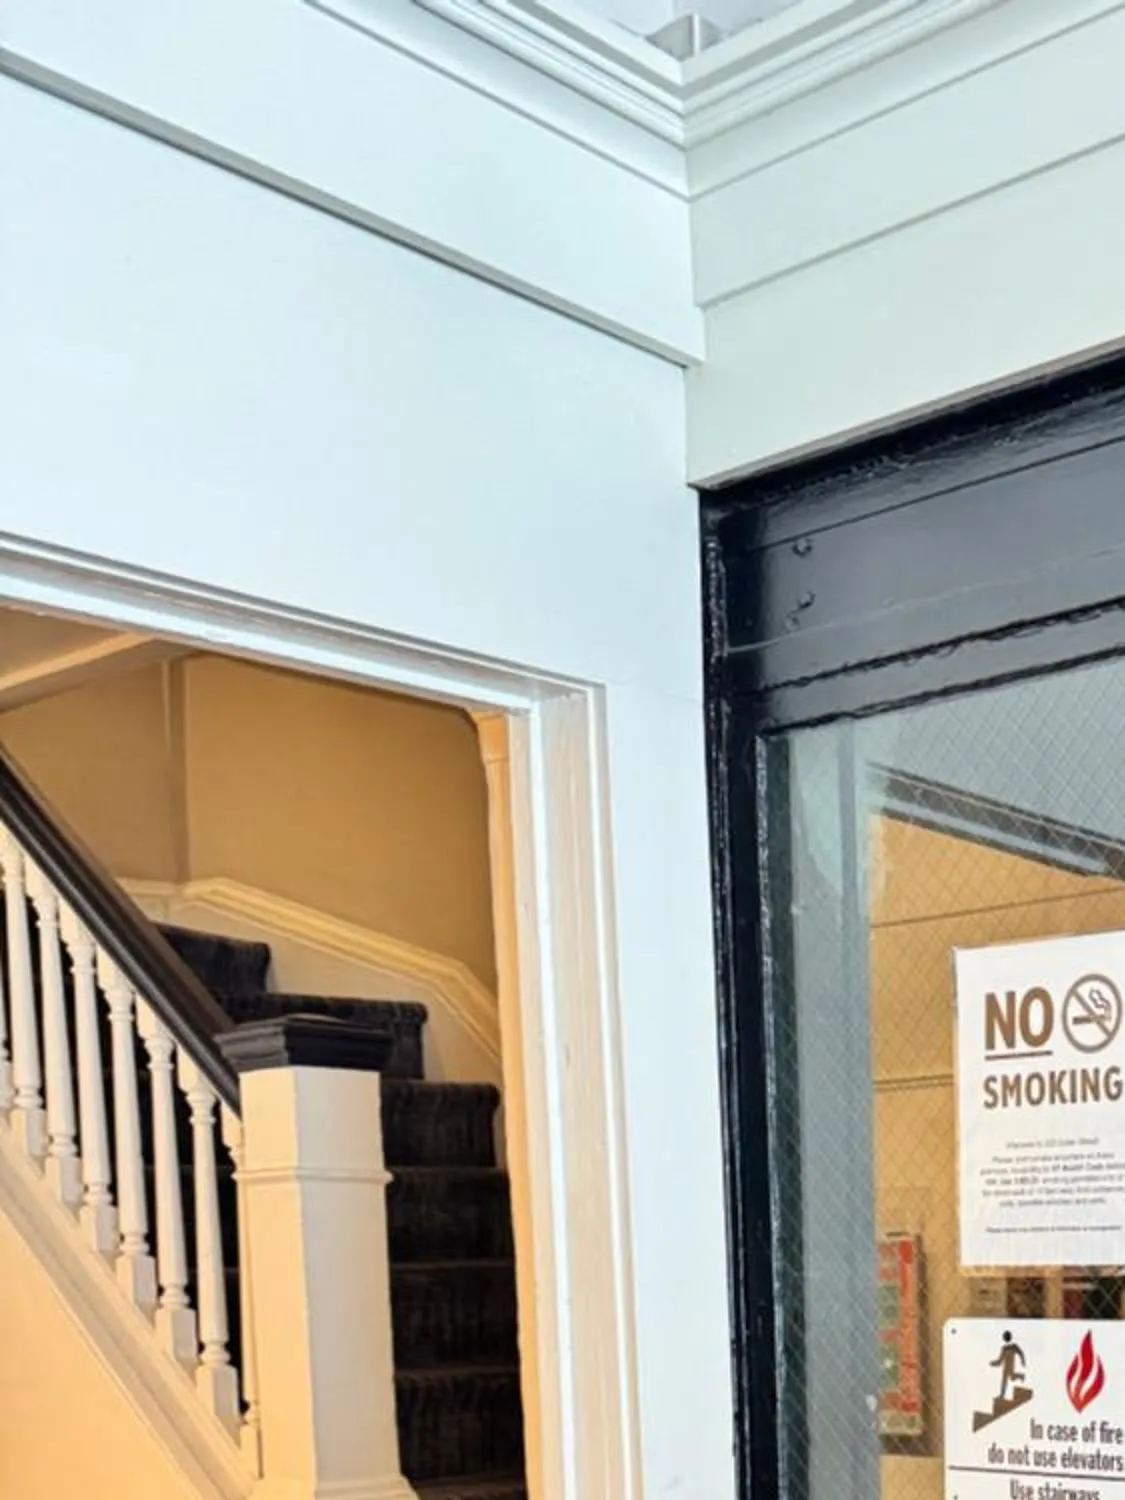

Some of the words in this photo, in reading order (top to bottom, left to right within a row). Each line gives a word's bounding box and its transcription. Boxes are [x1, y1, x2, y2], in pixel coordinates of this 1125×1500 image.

[984, 986, 1054, 1051] NO
[983, 1065, 1124, 1110] SMOKING
[1030, 1418, 1043, 1441] In
[1047, 1424, 1077, 1443] case
[1081, 1421, 1096, 1443] of
[1099, 1420, 1124, 1445] fire
[988, 1442, 1004, 1465] do
[1007, 1446, 1030, 1467] not
[1033, 1449, 1057, 1468] use
[1060, 1447, 1125, 1472] elevators
